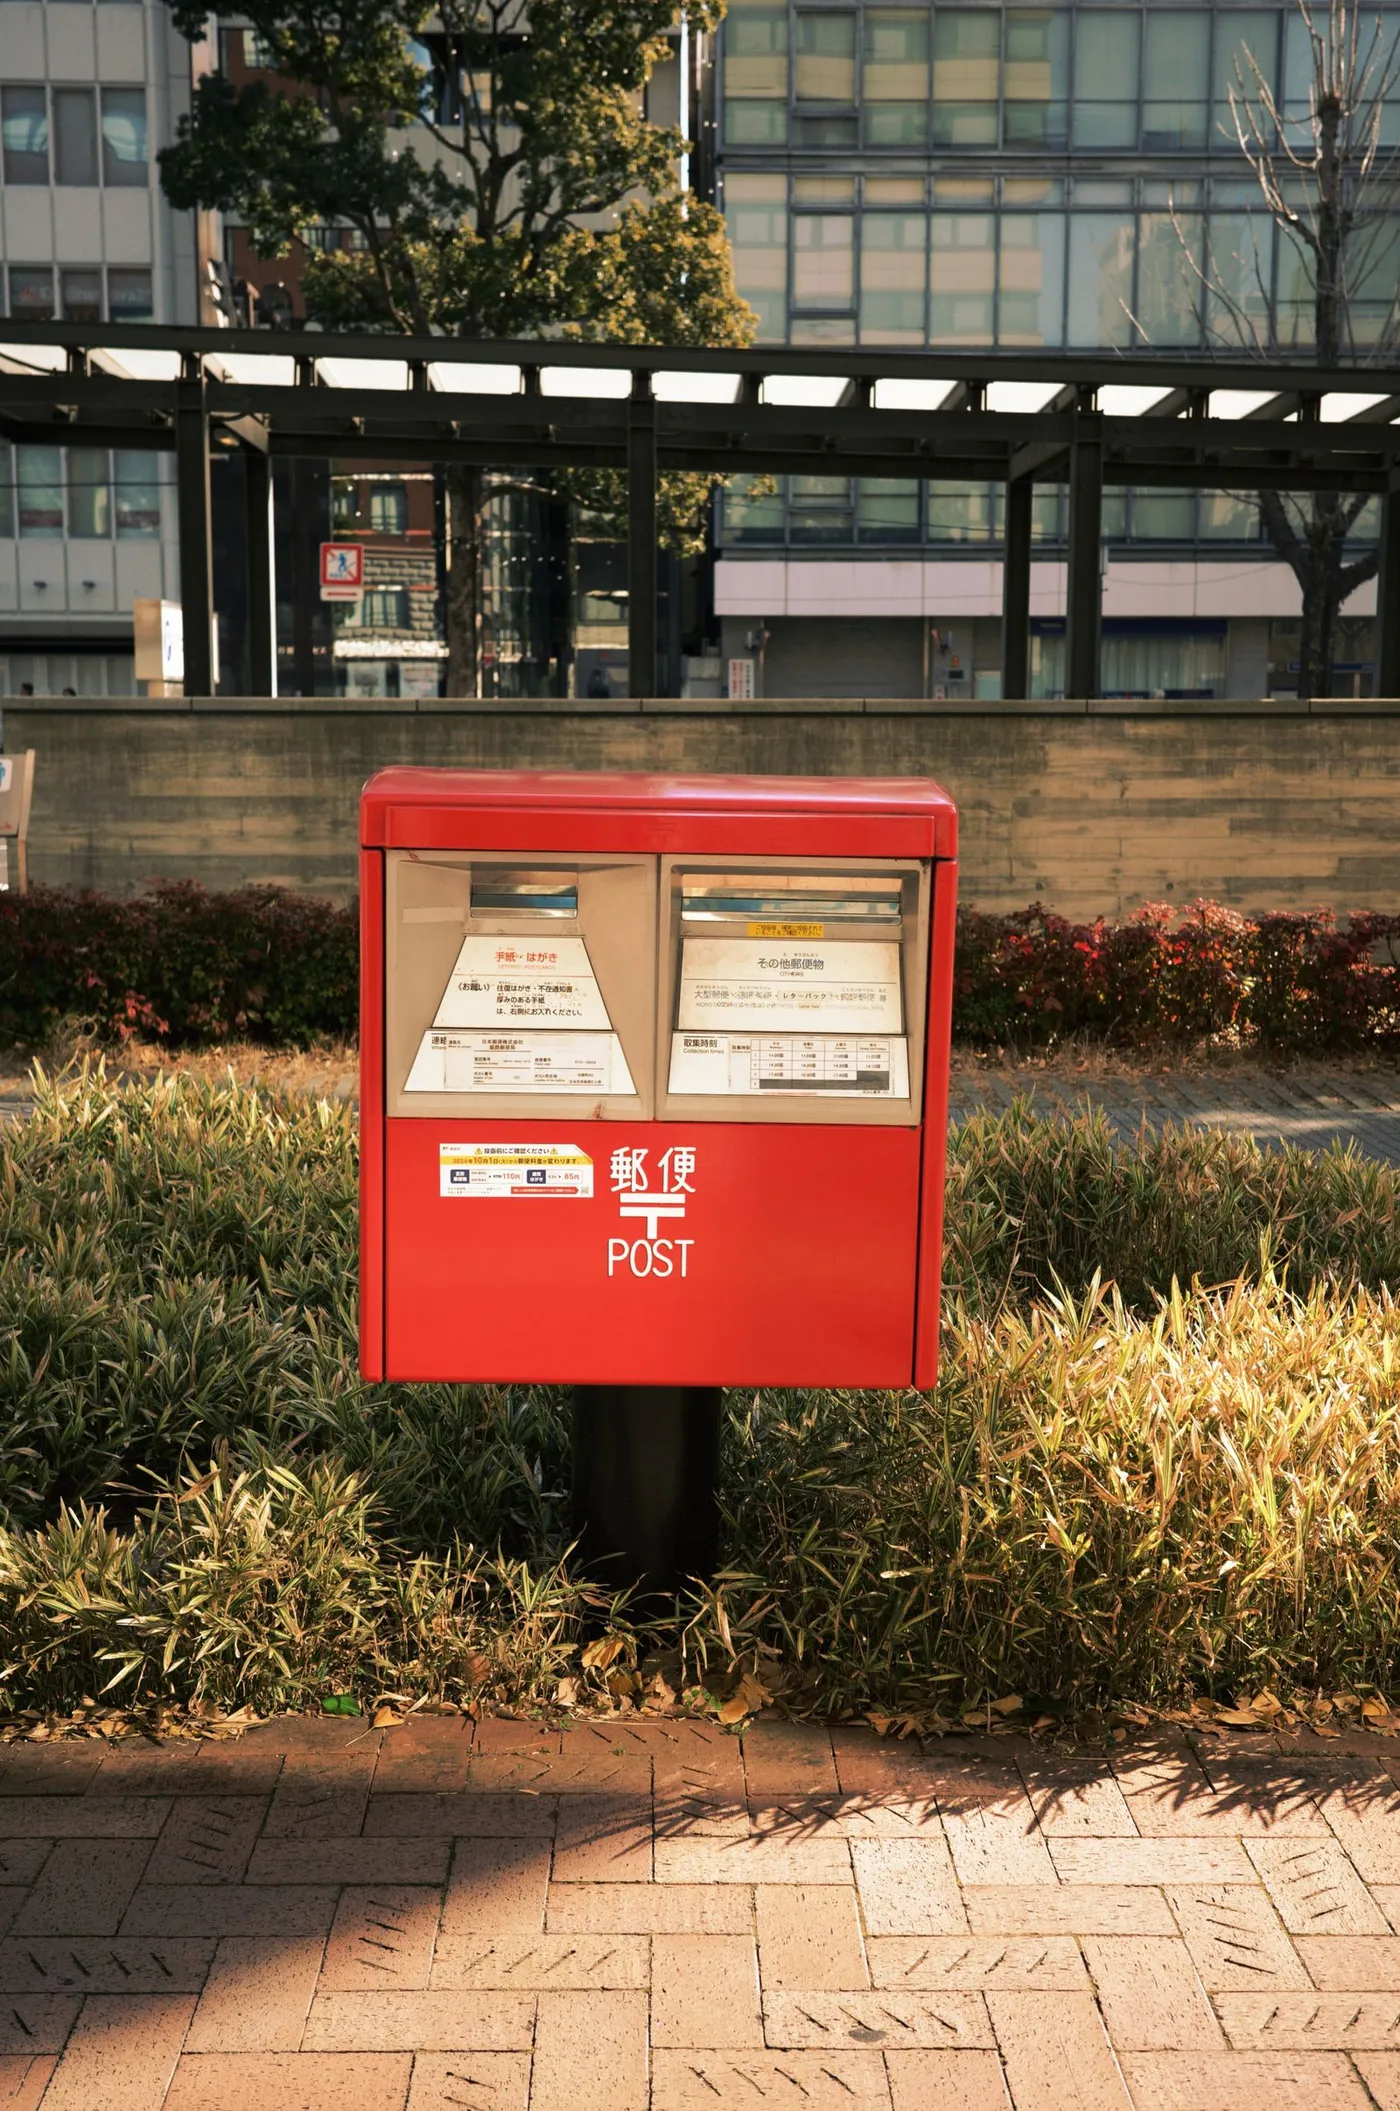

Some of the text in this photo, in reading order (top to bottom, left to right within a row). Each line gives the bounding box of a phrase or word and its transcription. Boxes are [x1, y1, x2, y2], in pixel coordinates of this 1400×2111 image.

[495, 951, 558, 963] 手紙・はがき
[757, 958, 824, 970] その他郵便物
[496, 996, 545, 1004] 厚みのある手紙
[683, 1038, 718, 1048] 取集時刻
[484, 1147, 550, 1155] 投函前にご確認ください
[610, 1146, 697, 1193] 郵便
[608, 1238, 695, 1278] POST
